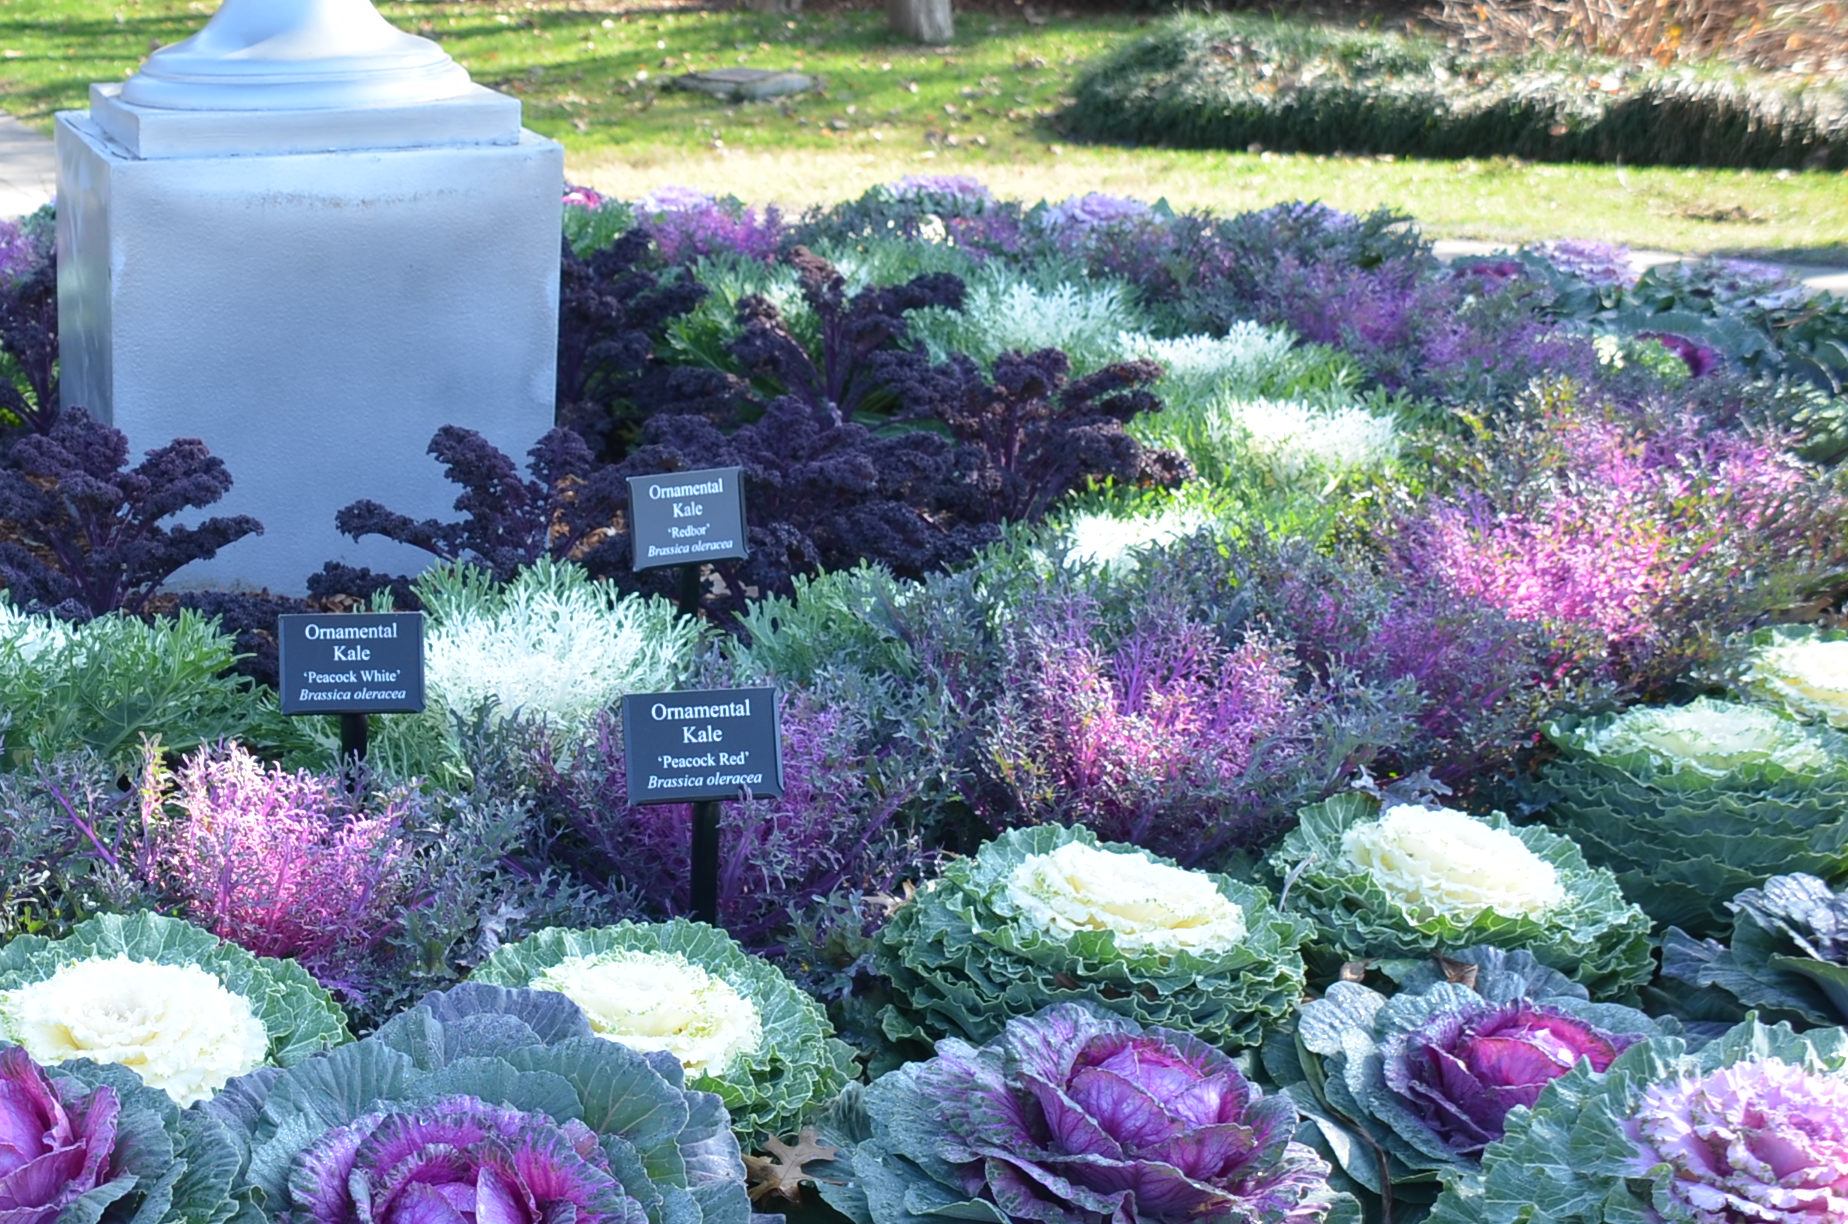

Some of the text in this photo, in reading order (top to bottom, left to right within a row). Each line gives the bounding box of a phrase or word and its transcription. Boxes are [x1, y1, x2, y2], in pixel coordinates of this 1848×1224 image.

[649, 478, 723, 499] Ornamental
[673, 502, 702, 518] Kale
[648, 540, 733, 557] Brassica oleracea
[305, 622, 397, 639] Ornamental
[333, 645, 371, 661] Kale
[299, 687, 406, 701] Brassica oleracea
[652, 699, 750, 720] Ornamental
[682, 725, 723, 743] Kale
[648, 772, 762, 789] Brassica oleracea
